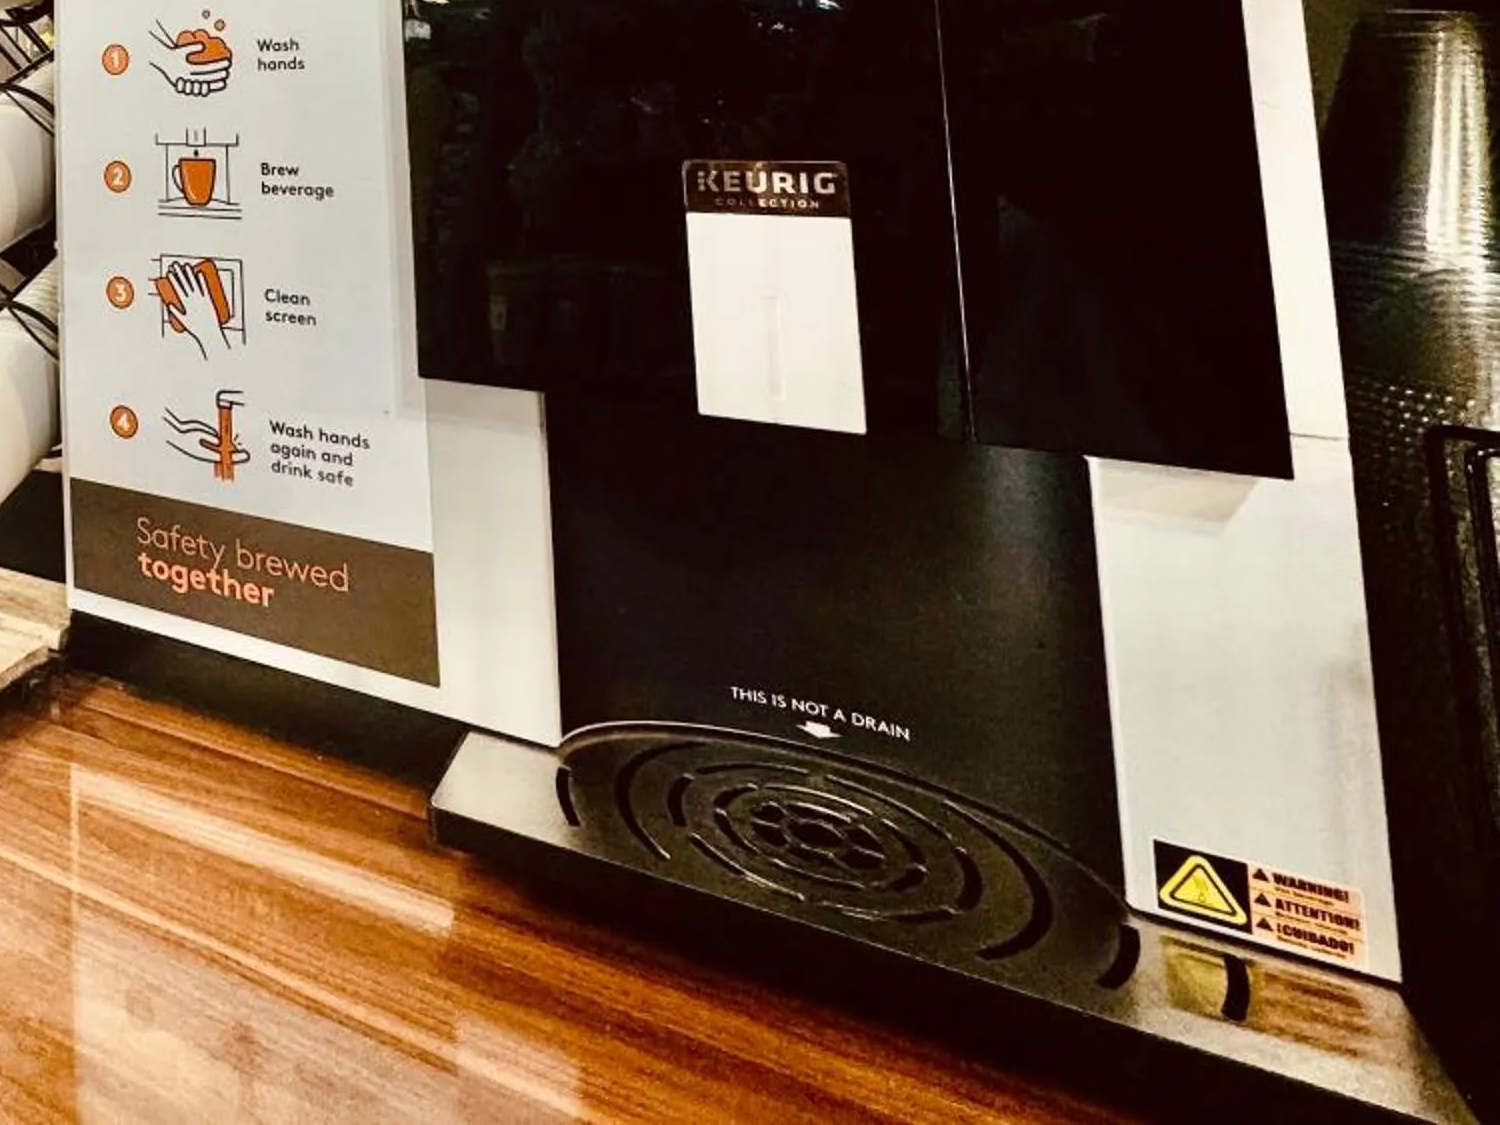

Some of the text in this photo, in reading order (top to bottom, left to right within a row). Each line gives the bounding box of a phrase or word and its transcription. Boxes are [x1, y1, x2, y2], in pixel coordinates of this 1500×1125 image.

[257, 38, 299, 54] Wash
[257, 58, 305, 72] hands
[261, 163, 300, 177] Brew
[697, 170, 837, 194] KEURIG
[262, 182, 334, 200] beverage
[264, 288, 311, 307] Clean
[265, 311, 318, 327] screen
[269, 419, 314, 440] Wash
[319, 427, 371, 449] hands
[270, 443, 353, 466] again and
[271, 459, 354, 487] drink safe
[137, 517, 350, 593] Safety brewed
[137, 552, 275, 608] together
[730, 686, 911, 742] THIS IS NOT A DRAIN
[1272, 872, 1349, 904] WARNING!
[1275, 898, 1360, 931] ATTENTION!
